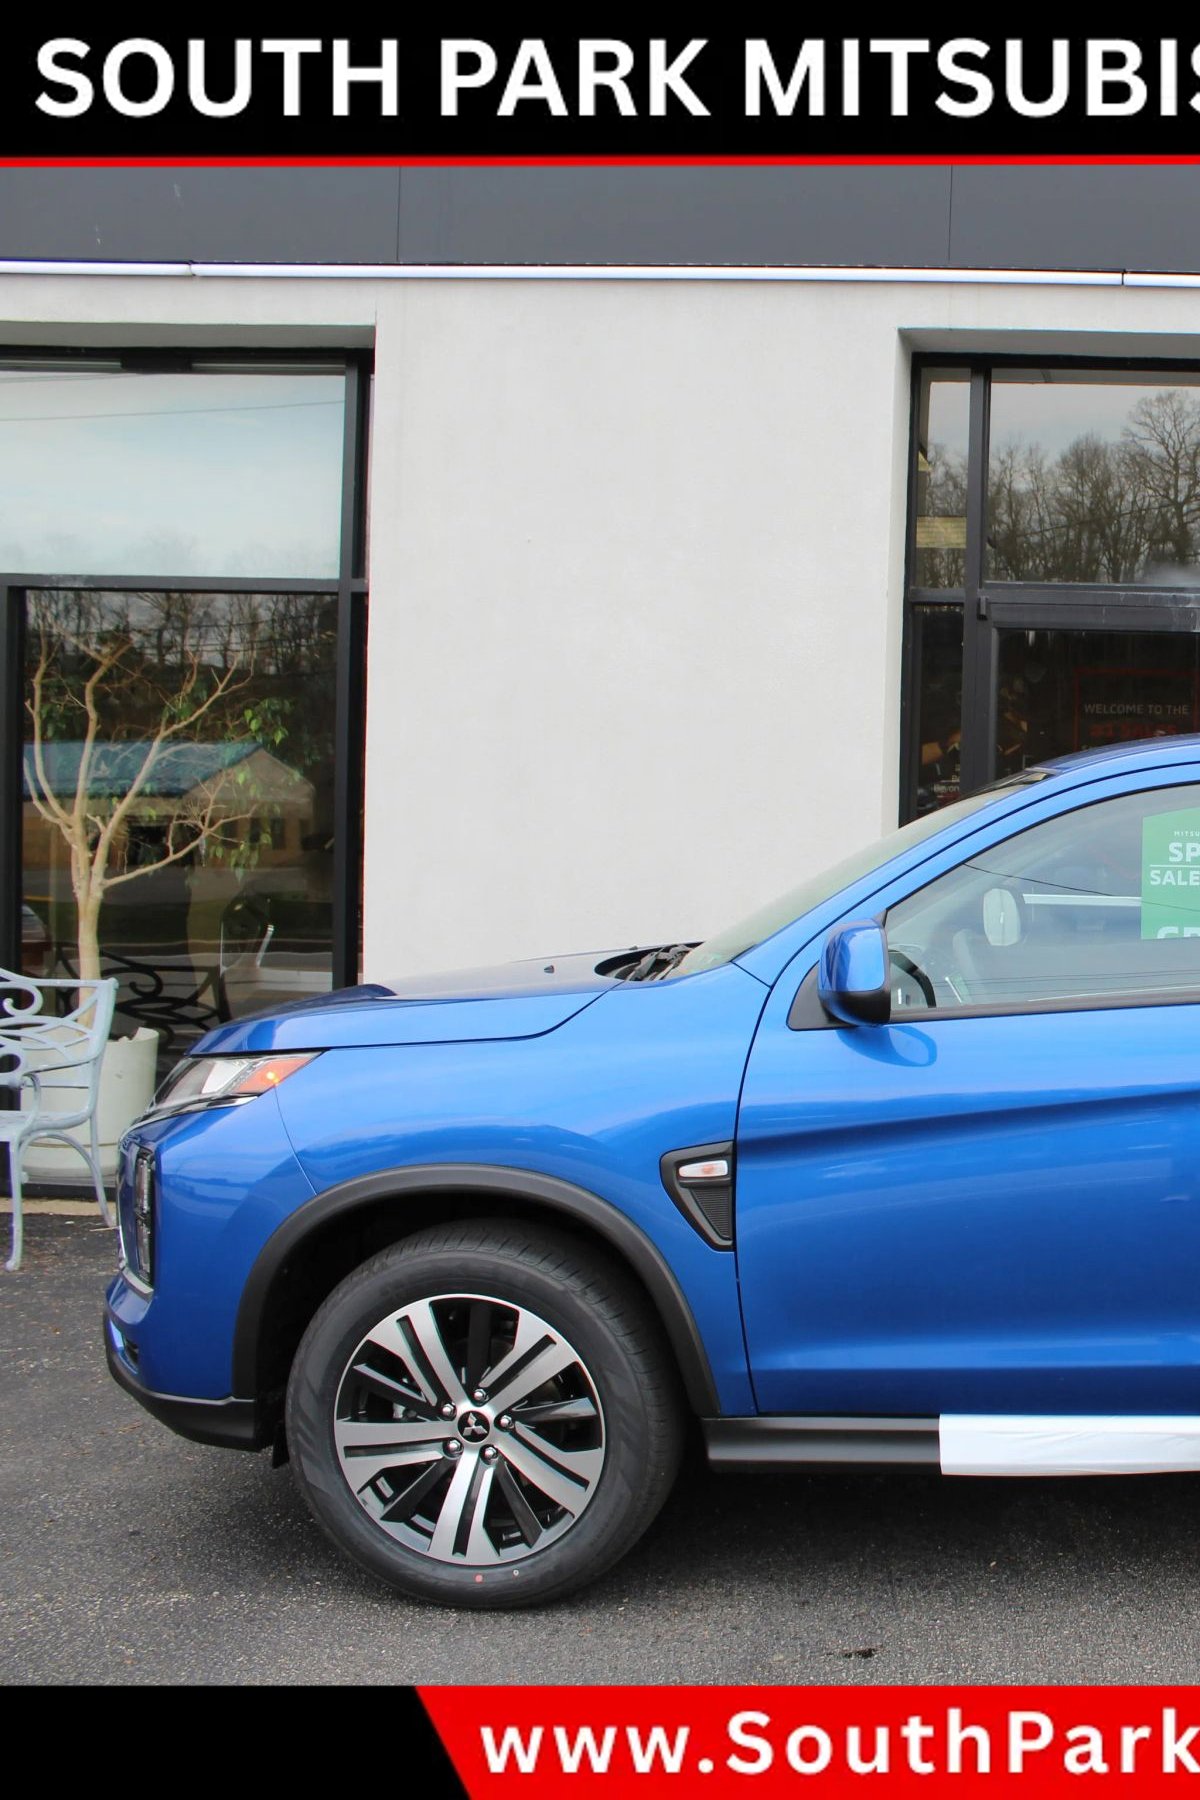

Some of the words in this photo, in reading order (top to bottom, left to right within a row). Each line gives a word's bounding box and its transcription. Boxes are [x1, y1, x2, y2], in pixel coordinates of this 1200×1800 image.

[1084, 703, 1145, 714] WELCOME
[1148, 704, 1162, 714] TO
[1167, 704, 1190, 715] THE
